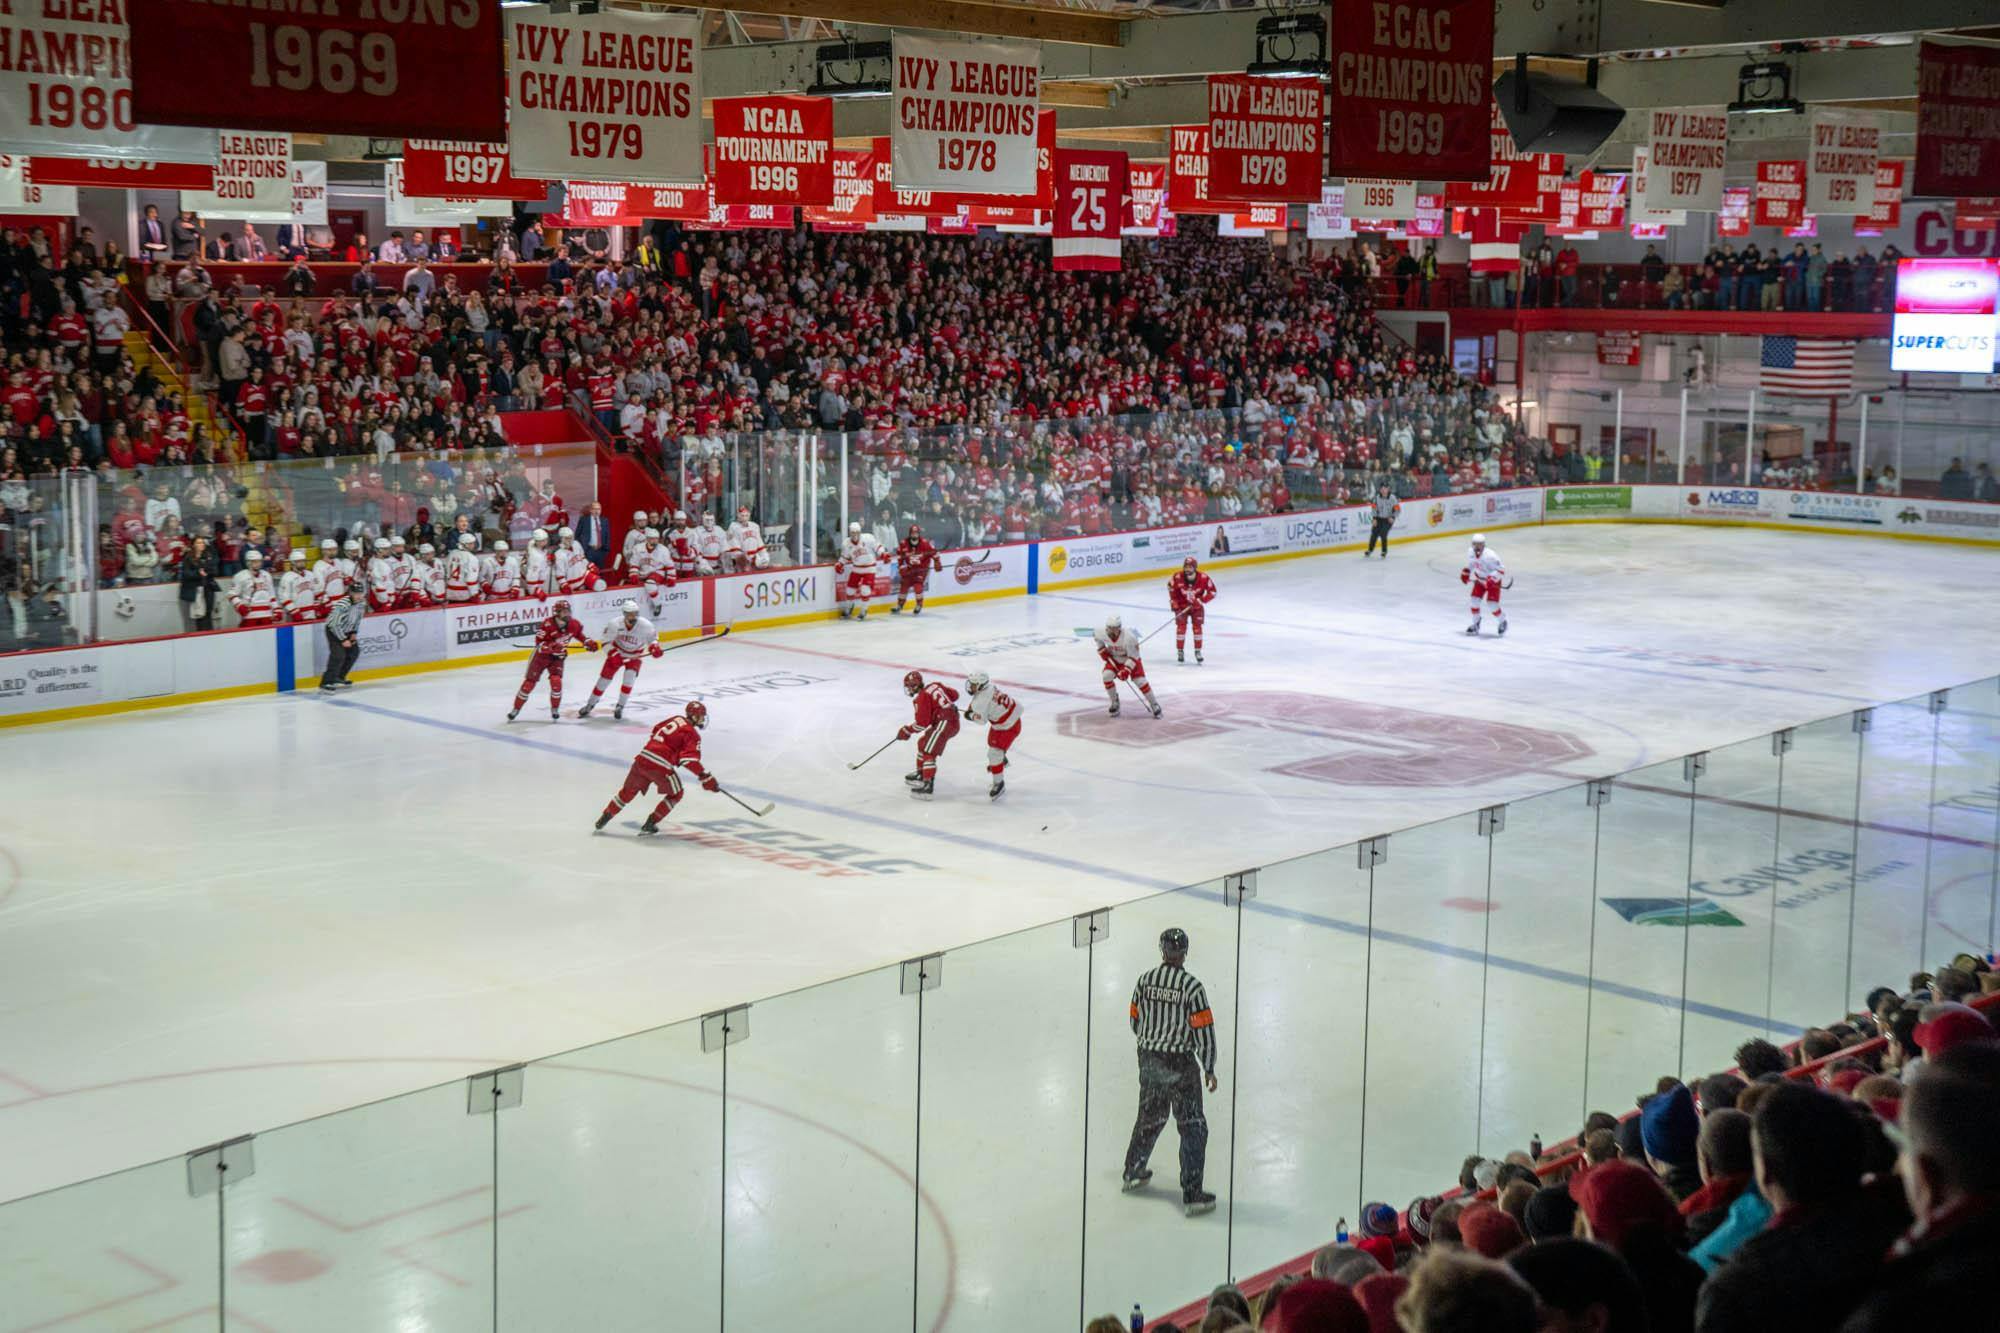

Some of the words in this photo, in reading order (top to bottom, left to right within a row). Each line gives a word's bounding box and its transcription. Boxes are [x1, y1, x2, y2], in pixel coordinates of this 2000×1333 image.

[1373, 4, 1450, 51] ECAC
[251, 22, 399, 96] 1969
[516, 23, 570, 64] IVY
[582, 30, 693, 74] LEAGUE
[899, 56, 939, 91] IVY
[950, 61, 1037, 98] LEAGUE
[1338, 52, 1484, 106] CHAMPIONS
[28, 82, 138, 132] 1980
[520, 70, 691, 119] CHAMPIONS
[1211, 83, 1241, 114] IVY
[1250, 86, 1319, 119] LEAGUE
[743, 107, 804, 134] NCAA
[901, 96, 1035, 137] CHAMPIONS
[1654, 112, 1678, 137] IVY
[1681, 114, 1726, 141] LEAGUE
[221, 135, 288, 156] LEAGUE
[568, 121, 643, 160] 1979
[1174, 130, 1199, 152] IVY
[1211, 119, 1316, 153] CHAMPIONS
[1378, 109, 1444, 156] 1969
[716, 136, 828, 165] TOURNAMENT
[938, 138, 996, 172] 1978
[1653, 142, 1724, 169] CHAMPIONS
[212, 158, 288, 178] AMPIONS
[444, 154, 505, 184] 1997
[750, 166, 798, 191] 1996
[833, 159, 857, 177] CAC
[1130, 170, 1154, 187] CAA
[1241, 155, 1287, 186] 1978
[1472, 165, 1511, 192] 77
[217, 179, 255, 199] 2010
[570, 185, 627, 201] TOURNAME
[1364, 187, 1394, 207] 1996
[1671, 171, 1702, 196] 1977
[592, 201, 619, 217] 2017
[654, 189, 684, 209] 2010
[749, 204, 775, 220] 2014
[1071, 187, 1107, 232] 25
[1250, 207, 1277, 223] 2005
[1896, 335, 1989, 350] SUPERCUTS
[1286, 517, 1348, 541] UPSCALE
[1069, 556, 1085, 569] GO
[1086, 554, 1103, 567] BIG
[1104, 552, 1124, 564] RED
[665, 591, 689, 602] LOFTS
[744, 576, 817, 609] SASAKI
[460, 624, 541, 641] MARKETPL
[683, 817, 942, 875] ECAC
[1690, 848, 1857, 897] Cayuga
[1146, 985, 1181, 1002] TERRERI
